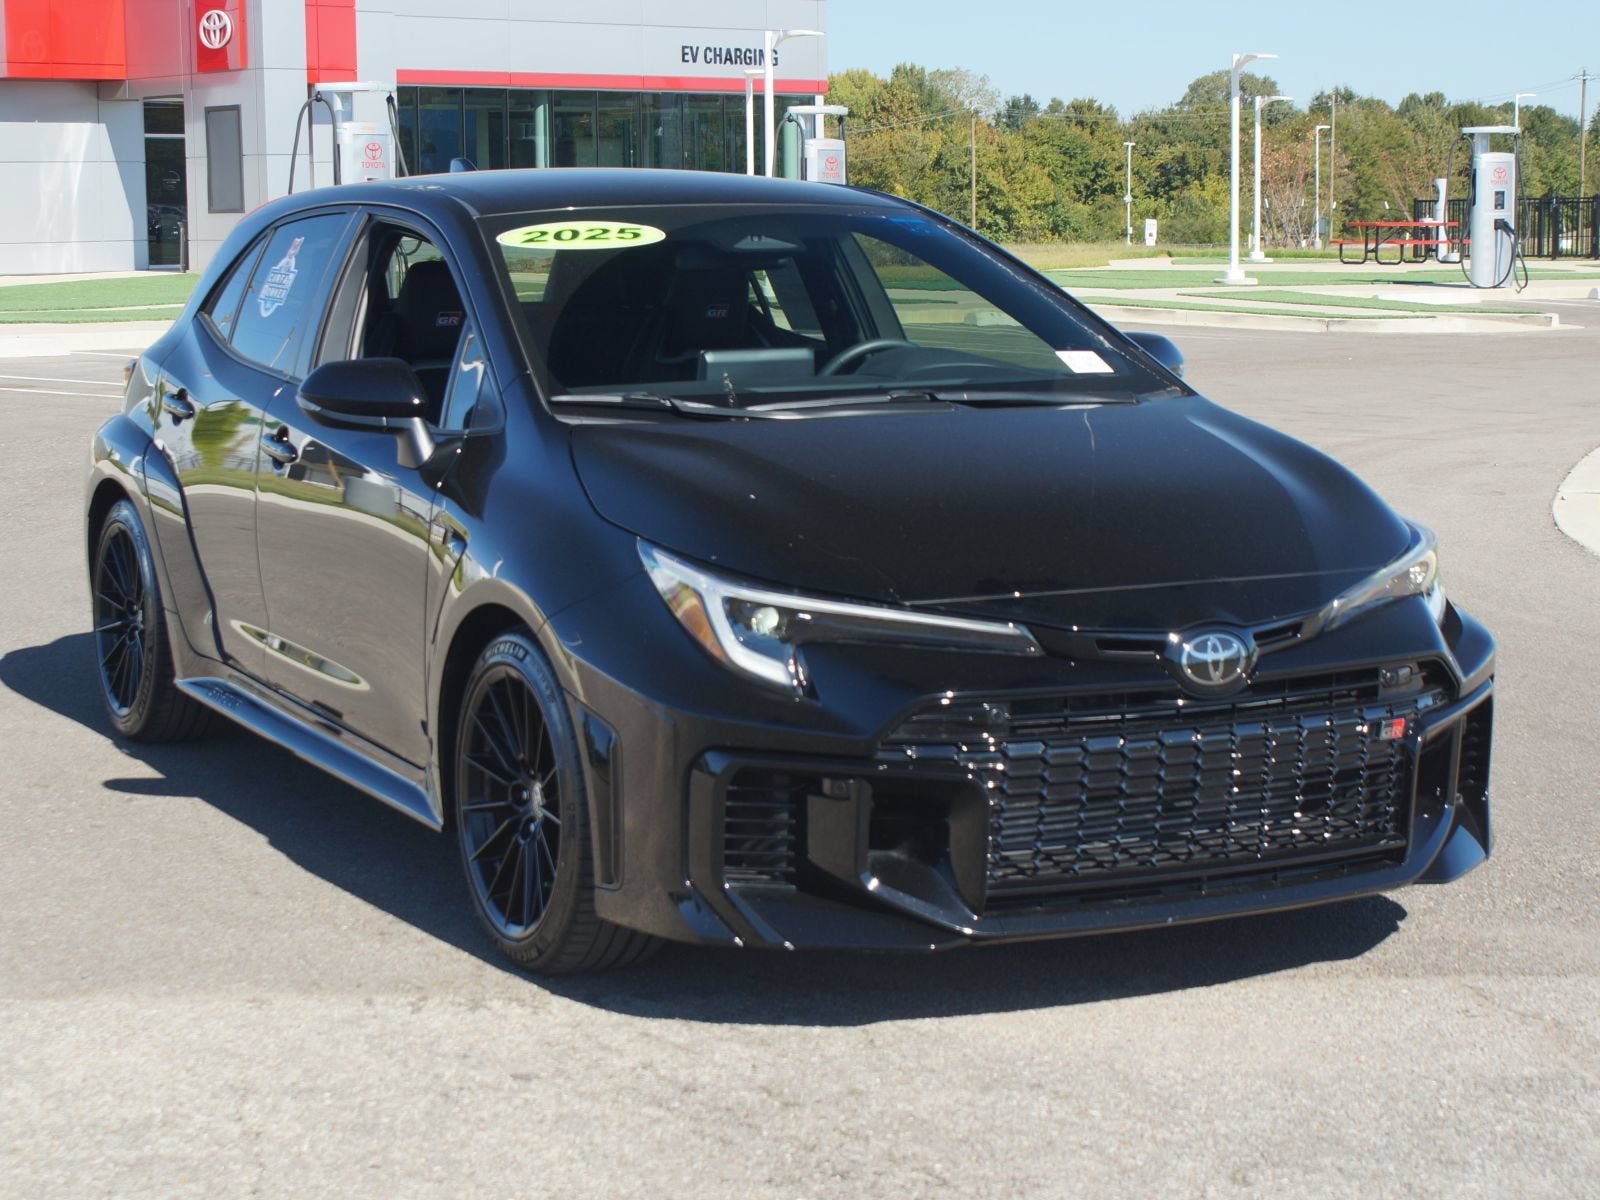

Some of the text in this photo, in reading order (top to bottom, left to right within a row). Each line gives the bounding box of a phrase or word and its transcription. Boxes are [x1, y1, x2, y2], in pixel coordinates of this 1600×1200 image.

[681, 45, 779, 66] EV CHARGING
[521, 227, 642, 244] 2025
[484, 641, 526, 660] MICHELIN
